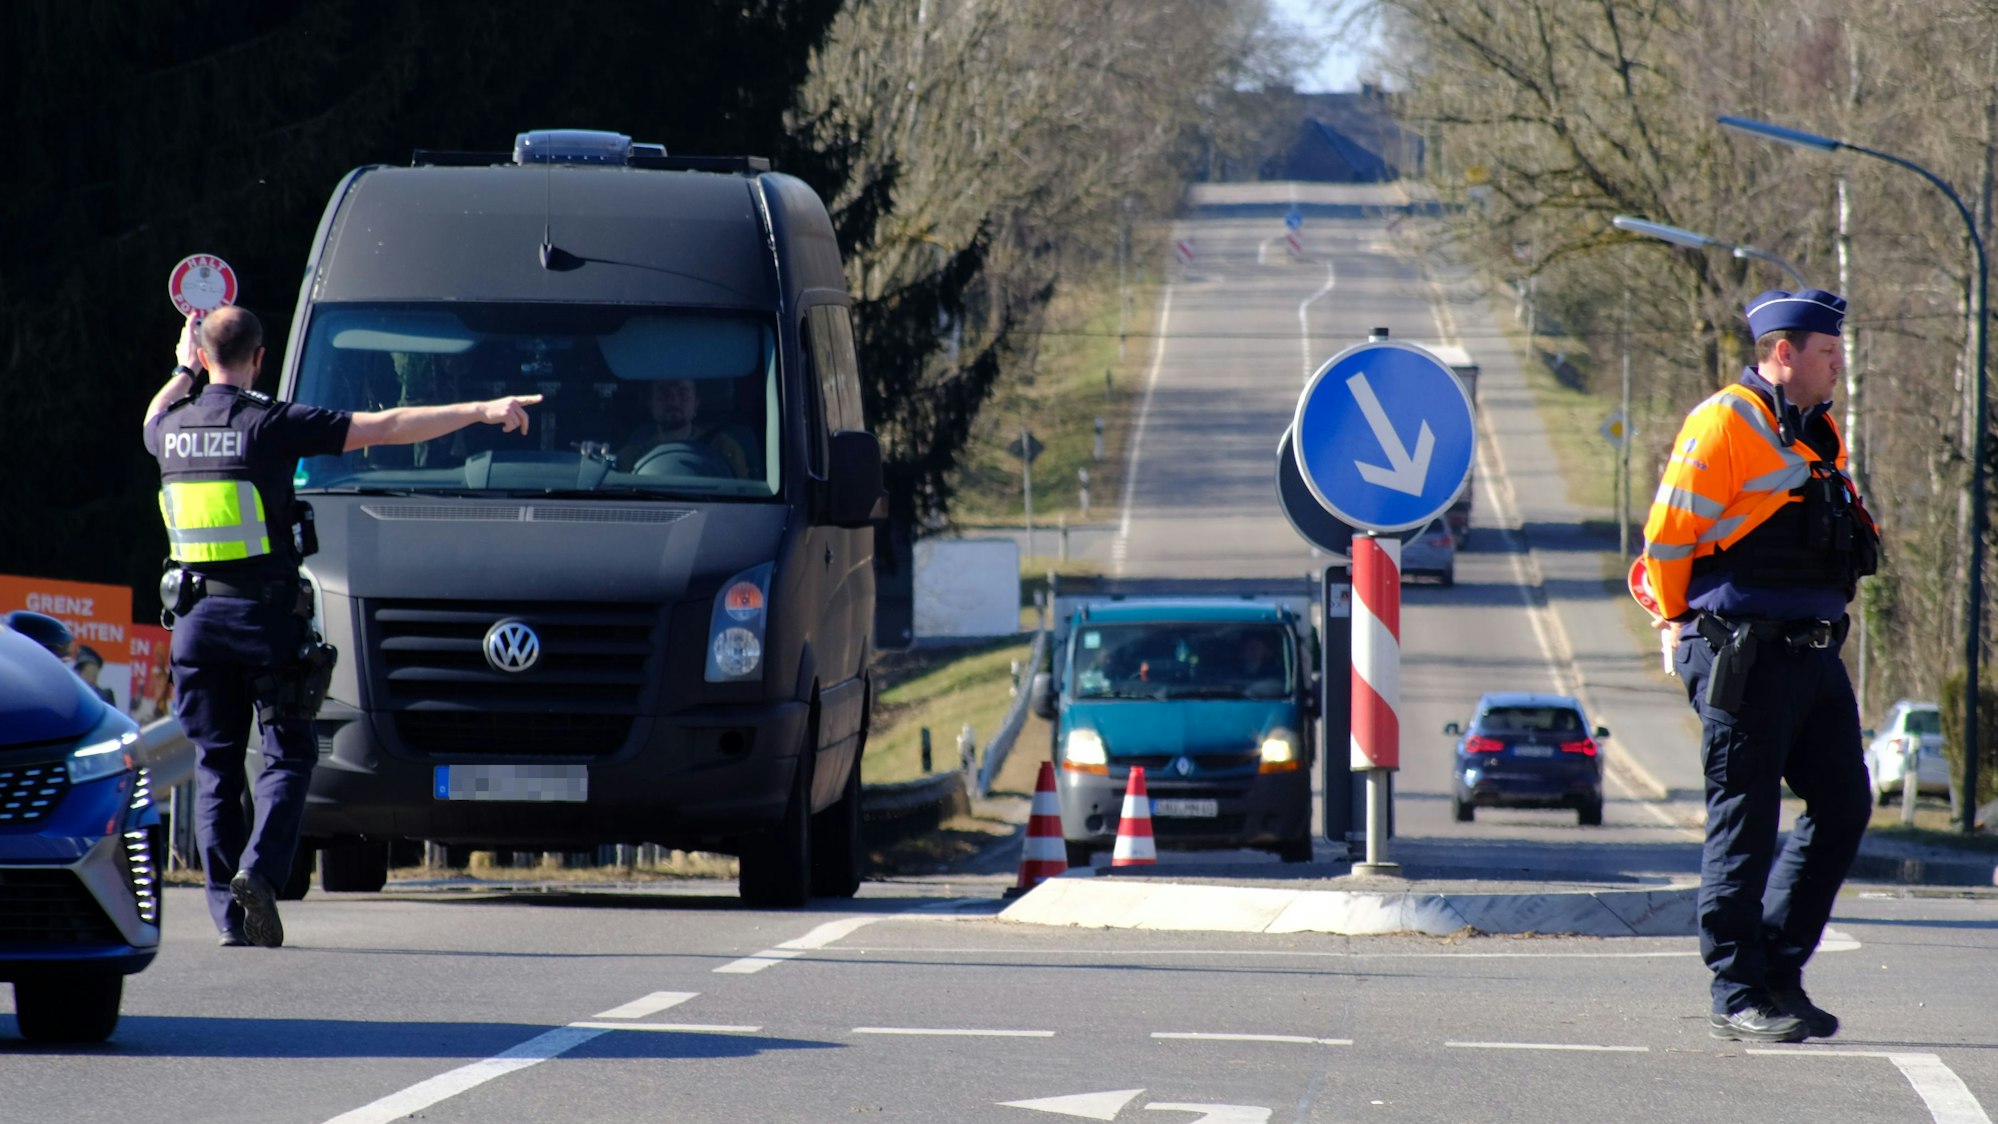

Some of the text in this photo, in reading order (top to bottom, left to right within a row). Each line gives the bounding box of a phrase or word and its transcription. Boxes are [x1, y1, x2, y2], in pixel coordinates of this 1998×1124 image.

[186, 257, 227, 270] HALT
[164, 431, 242, 458] POLIZEI
[26, 592, 95, 616] GRENZ
[490, 623, 538, 671] VW
